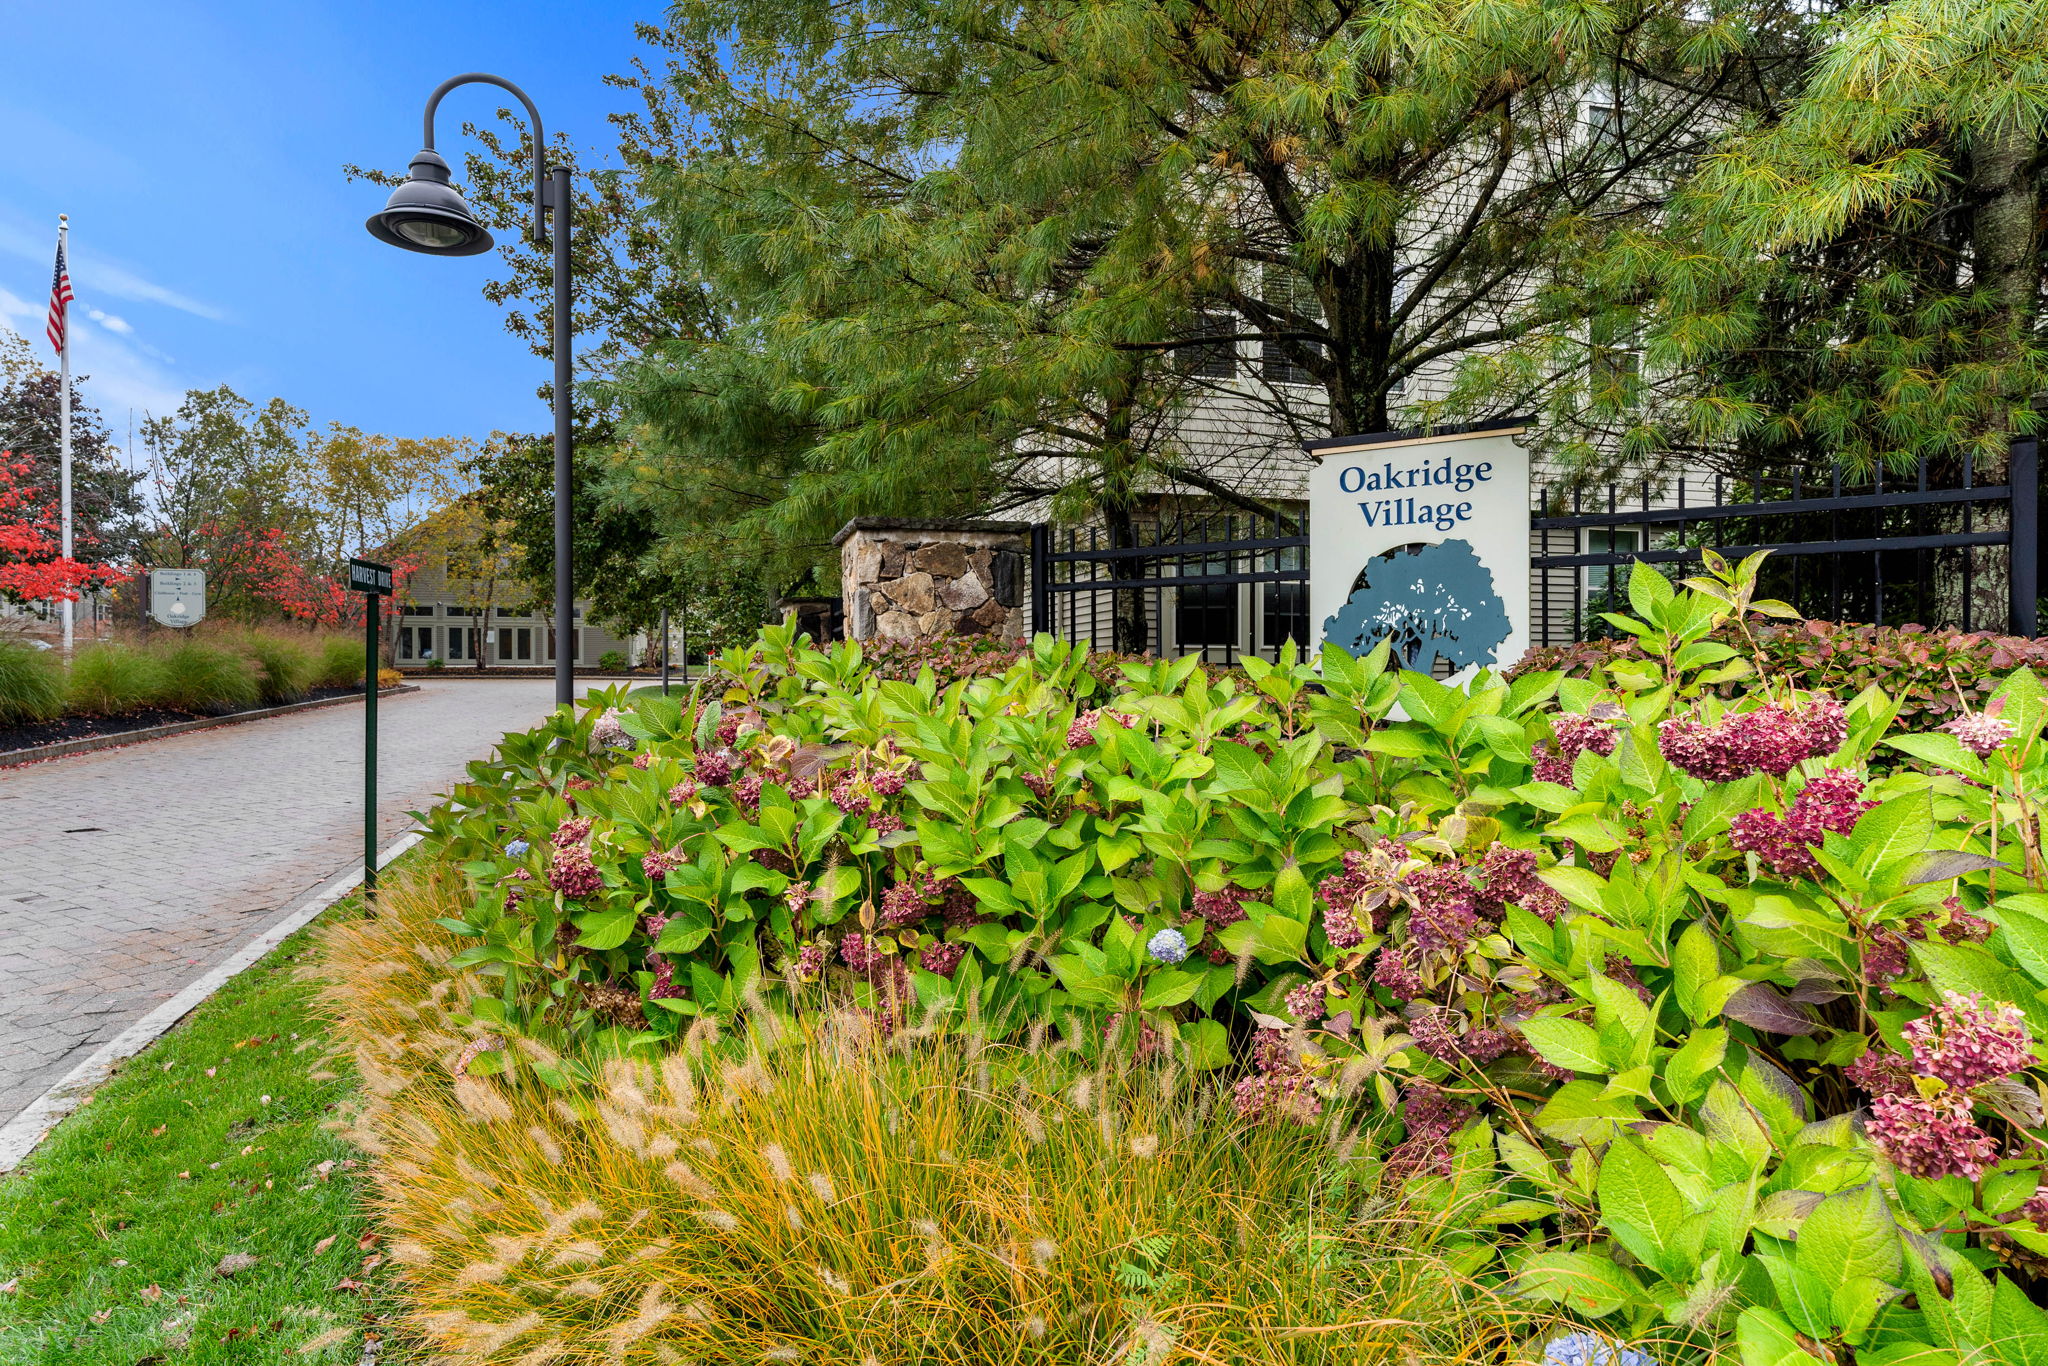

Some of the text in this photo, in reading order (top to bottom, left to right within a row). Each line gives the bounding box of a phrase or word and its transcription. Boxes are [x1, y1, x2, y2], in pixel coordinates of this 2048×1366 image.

[1339, 457, 1493, 493] Oakridge
[1358, 497, 1473, 531] Village
[351, 564, 391, 588] HARVEST DRIVE
